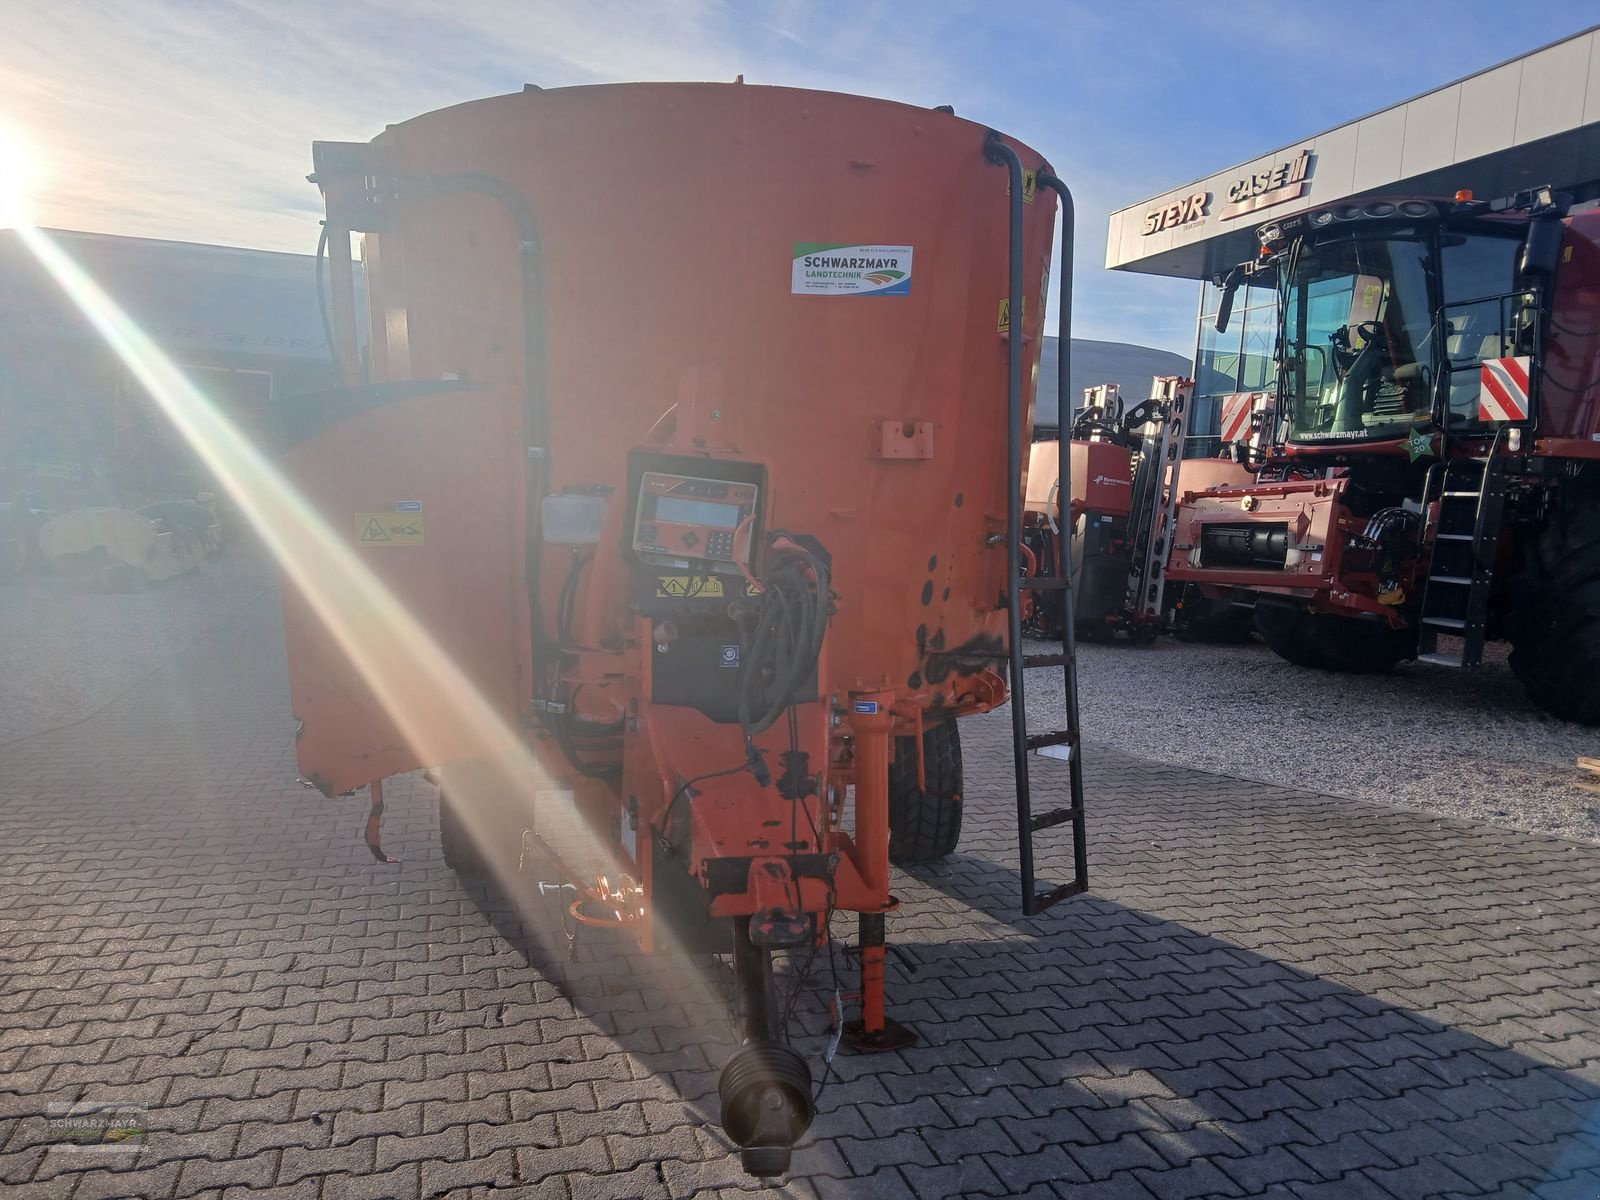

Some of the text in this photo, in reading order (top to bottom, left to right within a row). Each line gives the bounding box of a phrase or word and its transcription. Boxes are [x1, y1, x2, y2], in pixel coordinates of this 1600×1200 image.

[1225, 164, 1287, 204] CASE
[1142, 192, 1207, 236] STEYR
[804, 256, 898, 269] SCHWARZMAYR
[805, 270, 862, 279] LANDTECHNIK
[1299, 428, 1369, 441] www.schwarzmayr.at
[1408, 437, 1426, 447] TOP
[1414, 445, 1425, 454] 20
